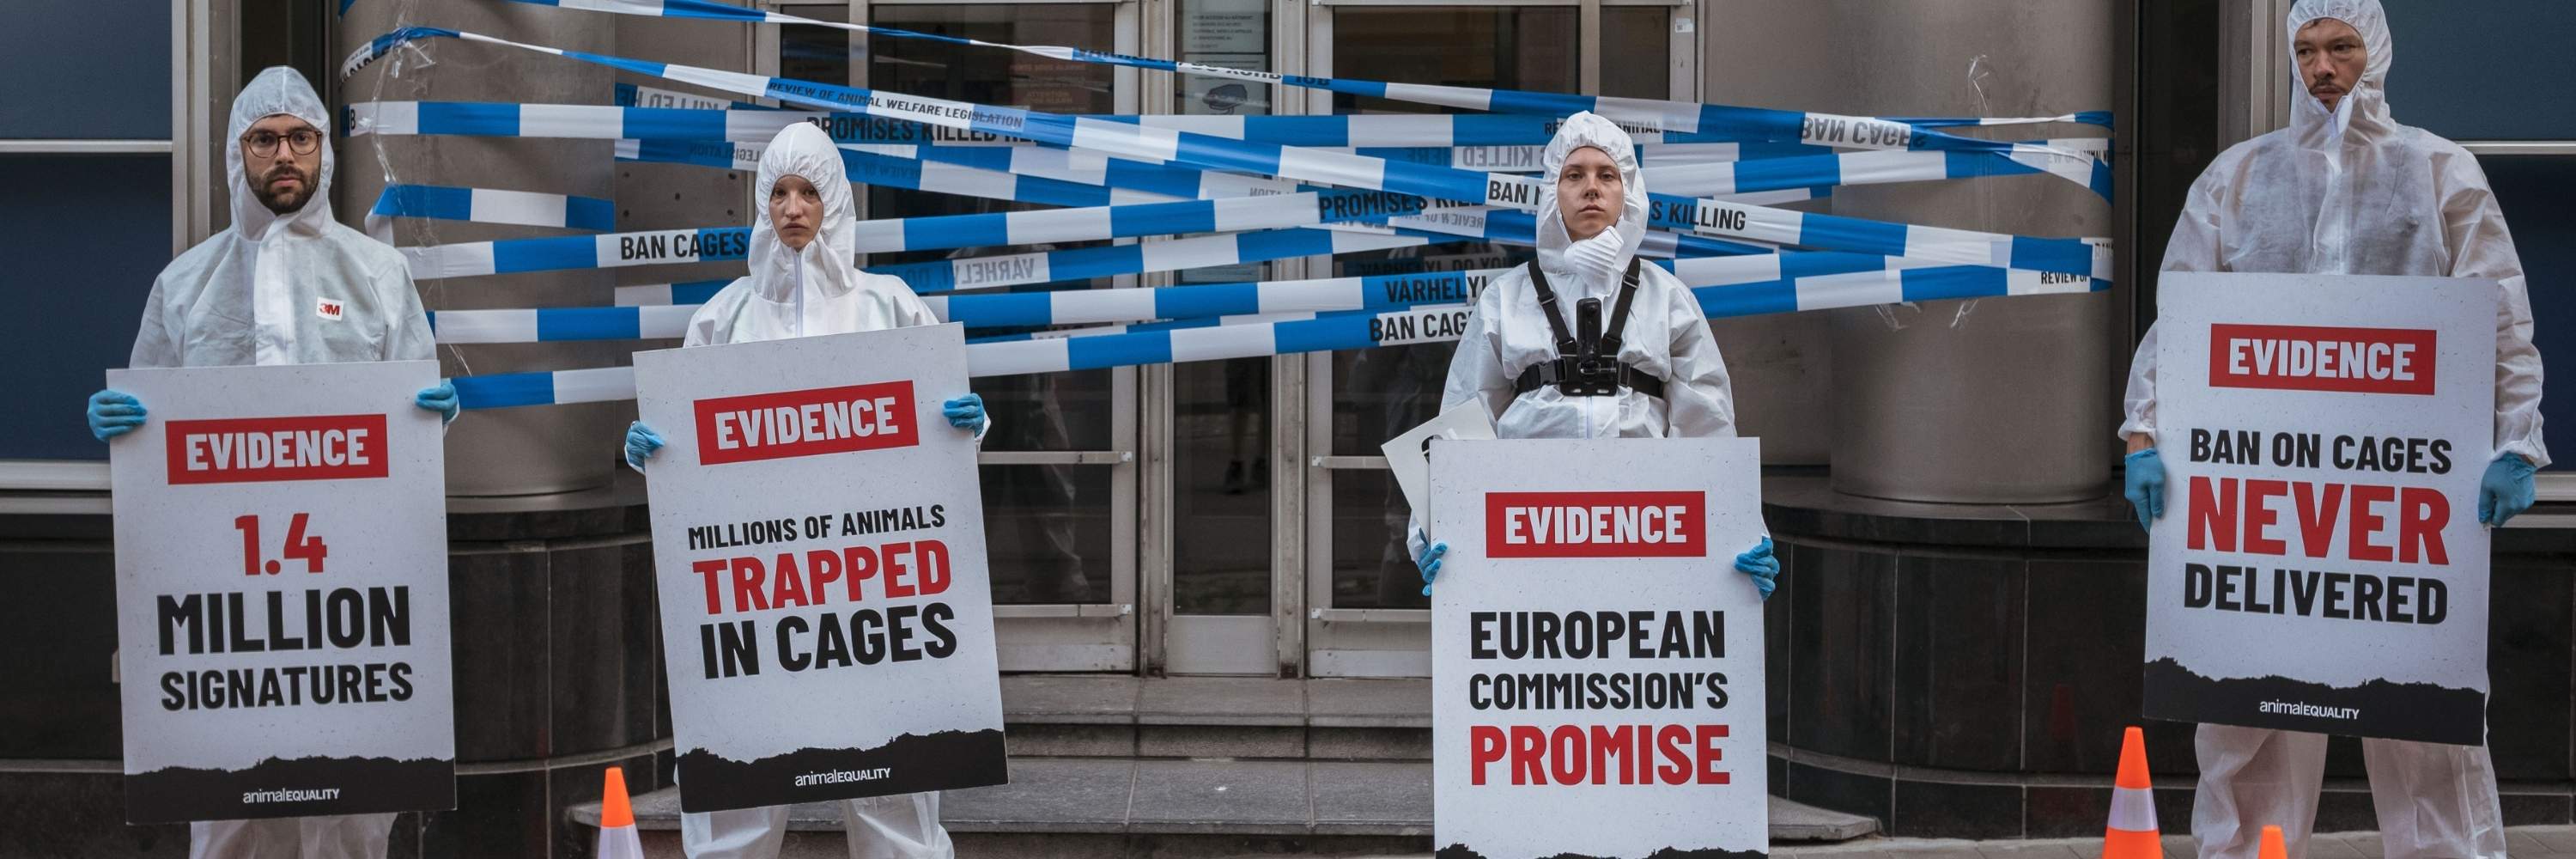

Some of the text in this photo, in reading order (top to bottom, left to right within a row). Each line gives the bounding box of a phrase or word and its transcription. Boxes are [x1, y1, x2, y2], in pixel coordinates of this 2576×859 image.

[768, 82, 1024, 127] REVIEW OF ANIMAL WELFARE LEGISLATION
[1488, 180, 1528, 204] BAN
[1668, 203, 1747, 230] KILLING
[621, 232, 747, 260] BAN CAGES
[319, 302, 340, 316] 3M
[1369, 310, 1473, 342] BAN CAG
[2228, 338, 2416, 381] EVIDENCE
[714, 396, 900, 451] EVIDENCE
[185, 428, 370, 472] EVIDENCE
[2190, 428, 2452, 475] BAN ON CAGES
[688, 504, 946, 551] MILLIONS OF ANIMALS
[1505, 505, 1687, 545] EVIDENCE
[2187, 475, 2451, 565] NEVER
[234, 512, 327, 576] 1.4
[692, 539, 952, 615] TRAPPED
[2184, 563, 2449, 624] DELIVERED
[156, 585, 411, 656] MILLION
[700, 601, 957, 679] IN CAGES
[1470, 610, 1726, 660] EUROPEAN
[161, 661, 414, 711] SIGNATURES
[1469, 672, 1729, 710] COMMISSION'S
[2259, 699, 2360, 720] animalEQUALITY
[795, 767, 891, 787] animalEQUALITY
[1470, 723, 1731, 786] PROMISE
[242, 788, 341, 804] animalEQUALITY
